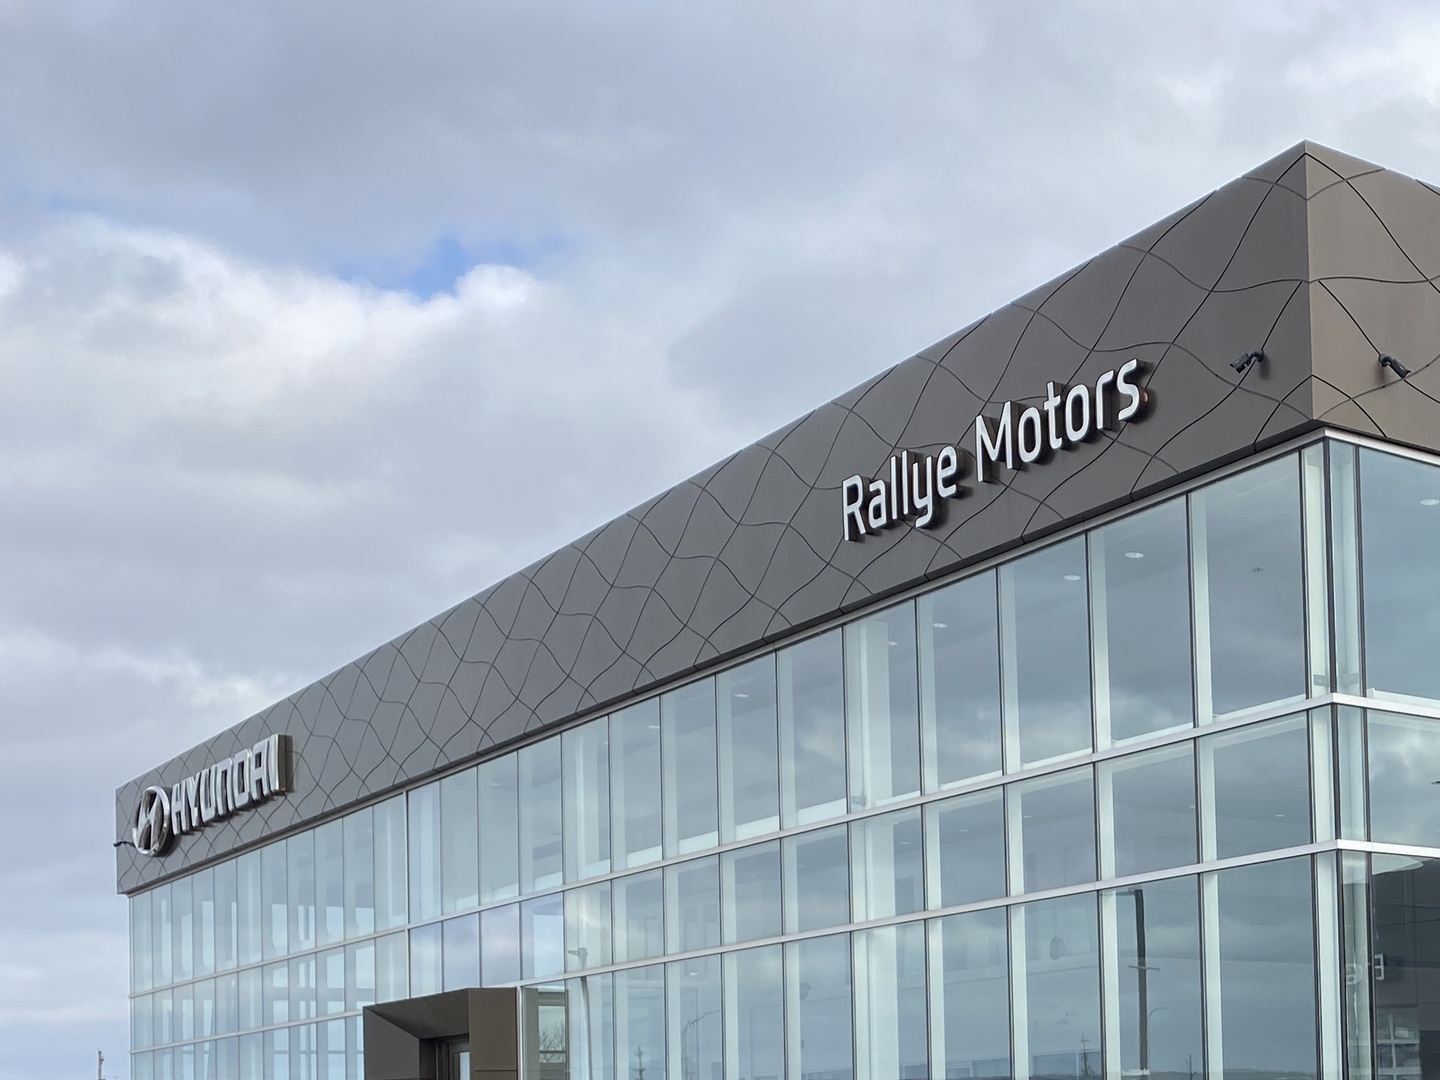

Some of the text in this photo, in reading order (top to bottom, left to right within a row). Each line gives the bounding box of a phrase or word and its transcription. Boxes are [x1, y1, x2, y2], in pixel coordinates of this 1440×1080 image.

[842, 358, 1144, 541] Rallye Motors
[171, 733, 284, 836] HYUNDAI
